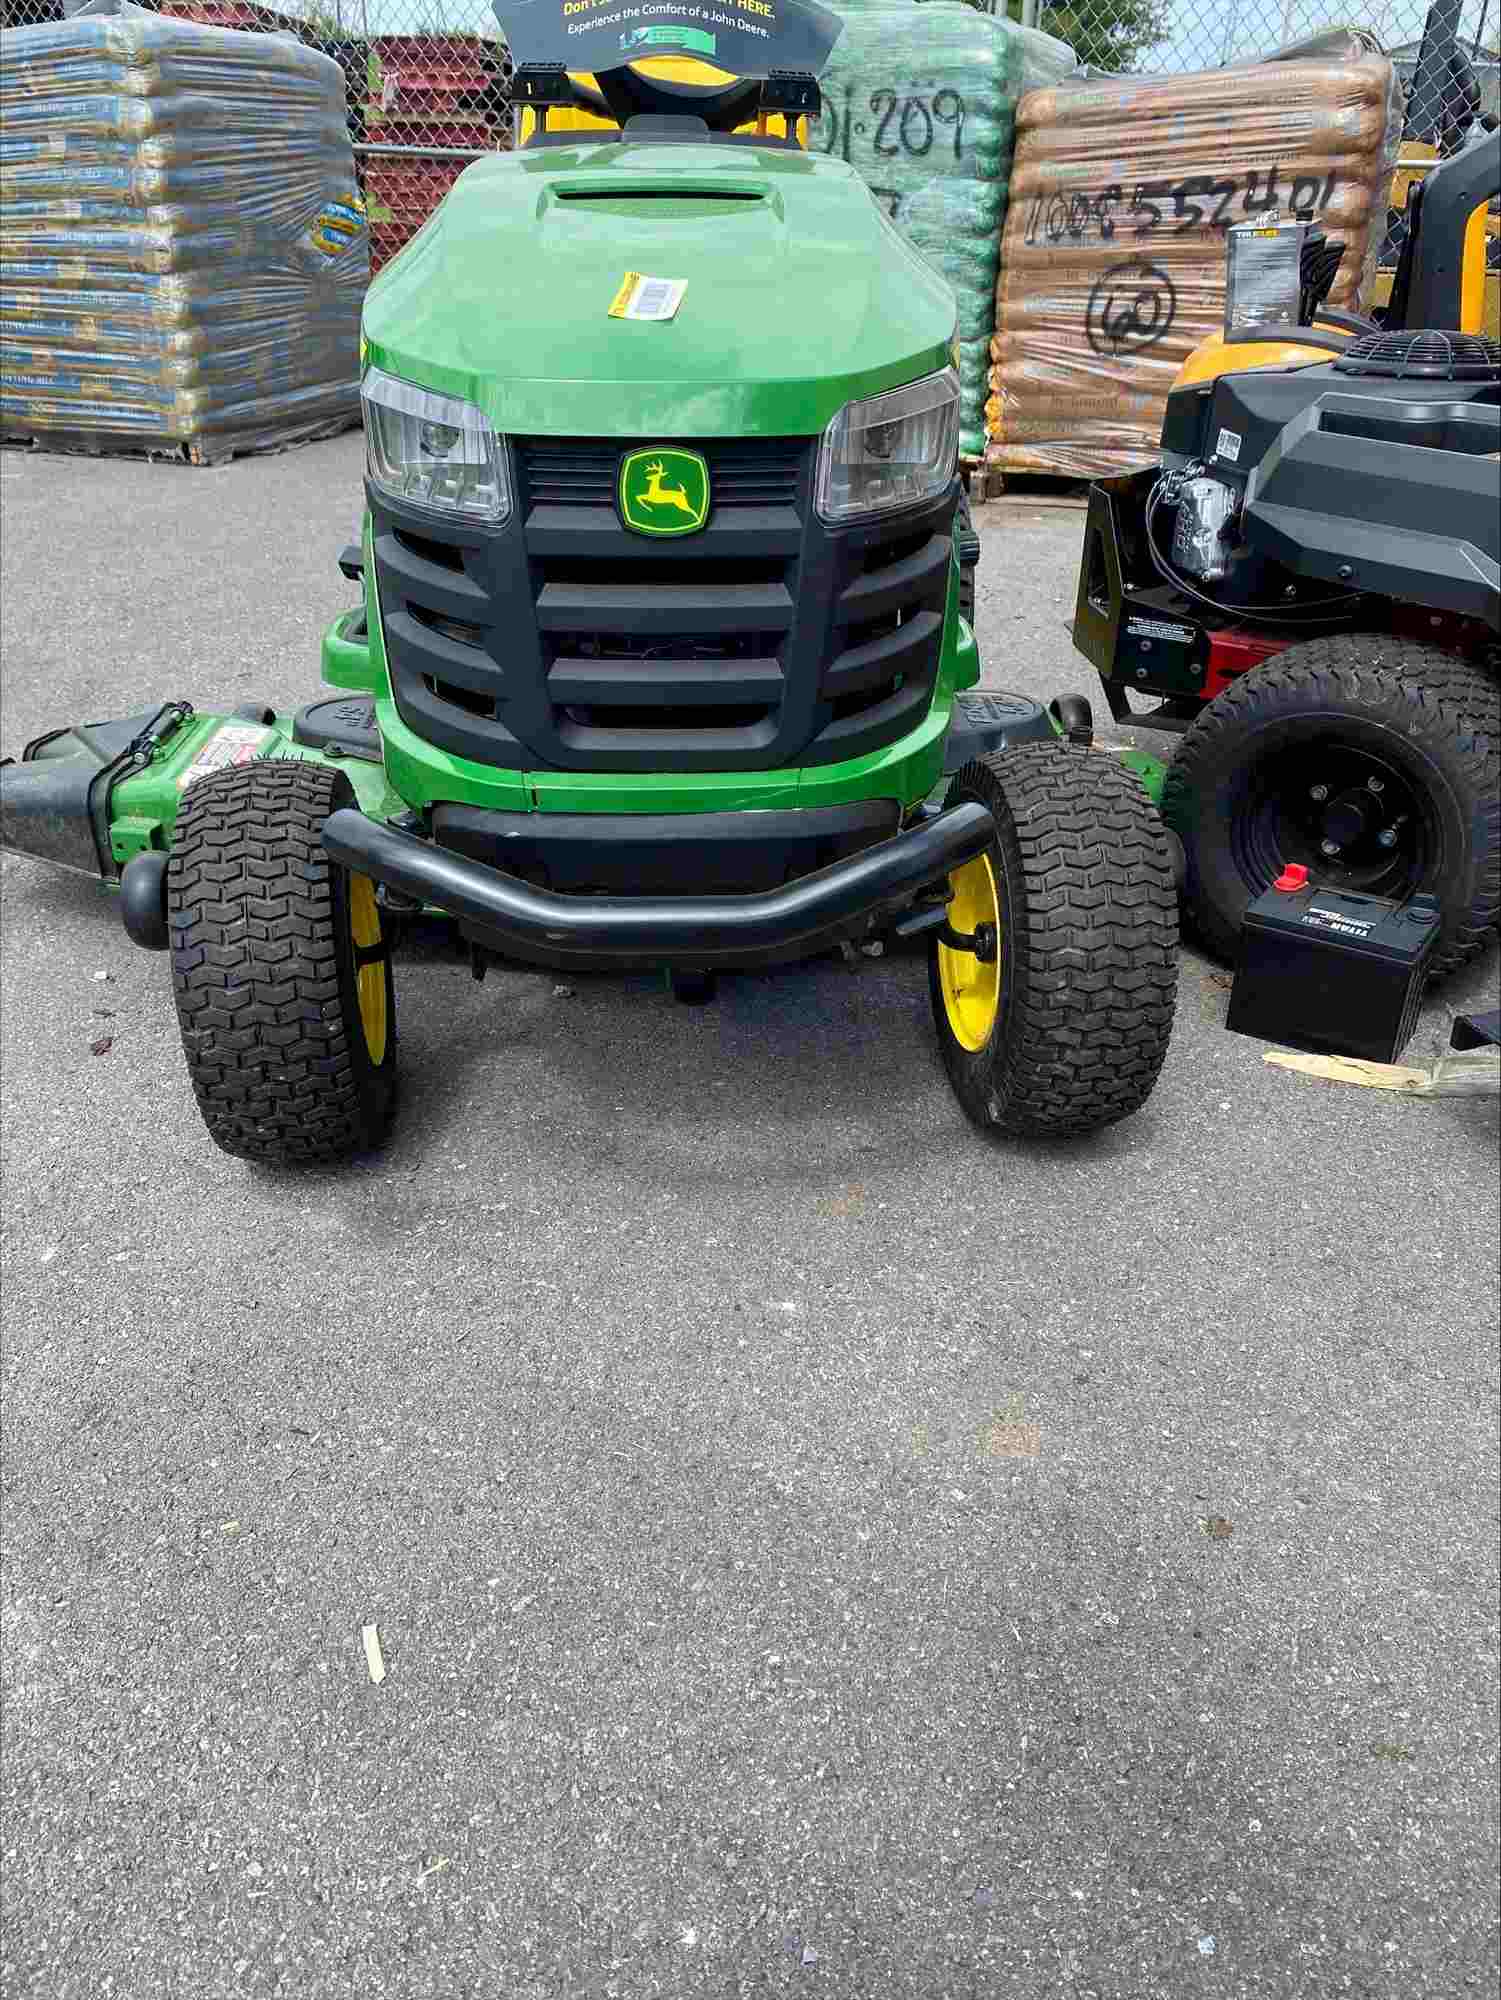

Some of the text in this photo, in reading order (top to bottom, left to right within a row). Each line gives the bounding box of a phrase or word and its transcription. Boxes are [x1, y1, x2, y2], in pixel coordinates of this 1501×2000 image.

[567, 12, 622, 35] Experience
[622, 7, 640, 18] the
[642, 4, 687, 15] Comfort
[688, 5, 701, 16] of
[710, 10, 736, 27] John
[737, 18, 770, 39] Deere.
